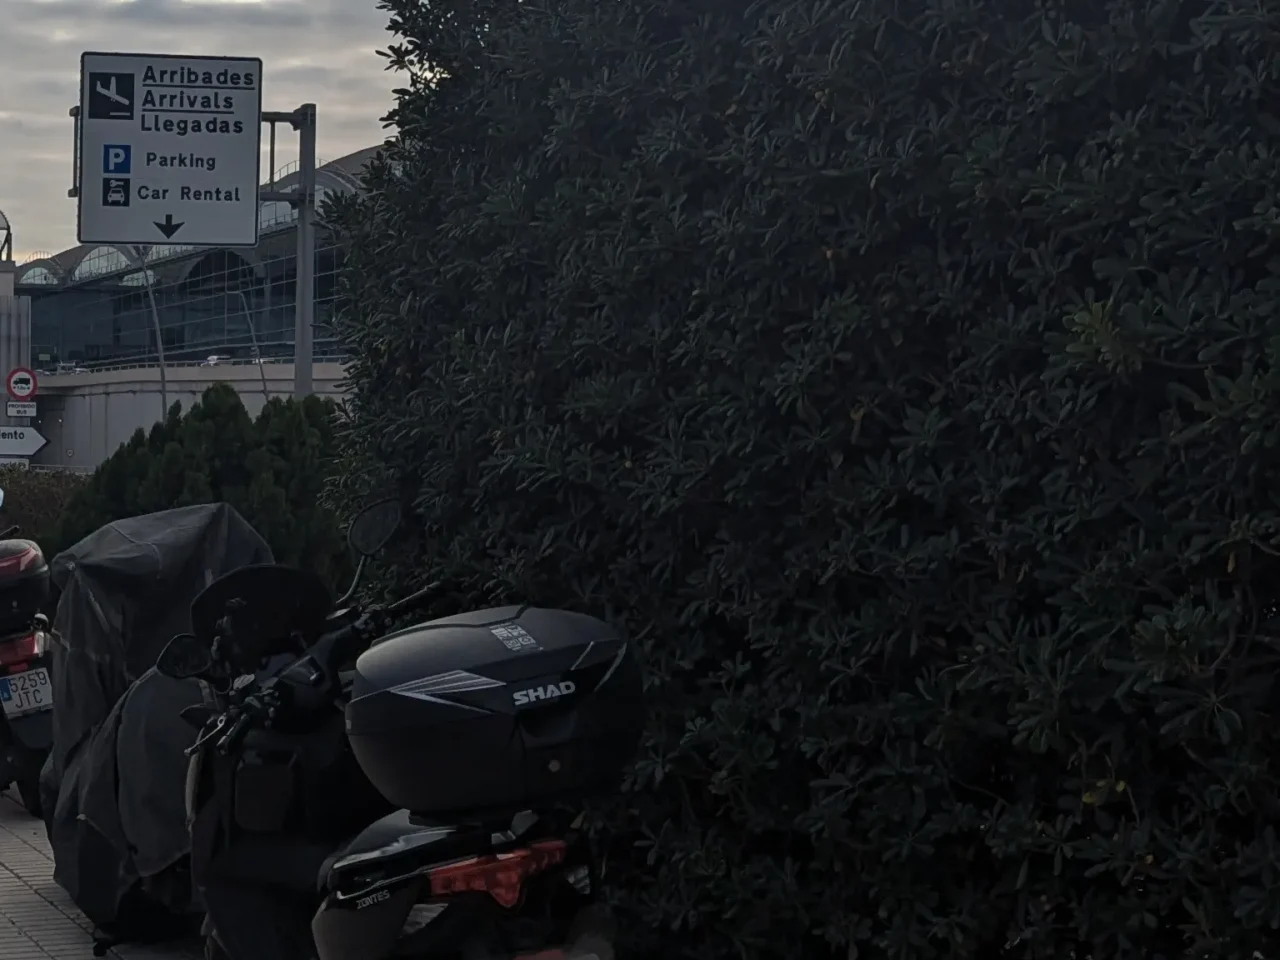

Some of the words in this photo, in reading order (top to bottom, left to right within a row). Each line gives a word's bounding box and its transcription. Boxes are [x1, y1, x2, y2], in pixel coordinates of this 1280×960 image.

[142, 65, 254, 86] Arribades
[141, 89, 233, 109] Arrivals
[140, 114, 244, 136] Llegadas
[108, 148, 126, 170] P
[146, 152, 216, 171] Parking
[137, 185, 169, 200] Car
[180, 186, 240, 202] Rental
[8, 671, 48, 693] 5259
[15, 689, 43, 708] JTC
[512, 680, 576, 706] SHAD
